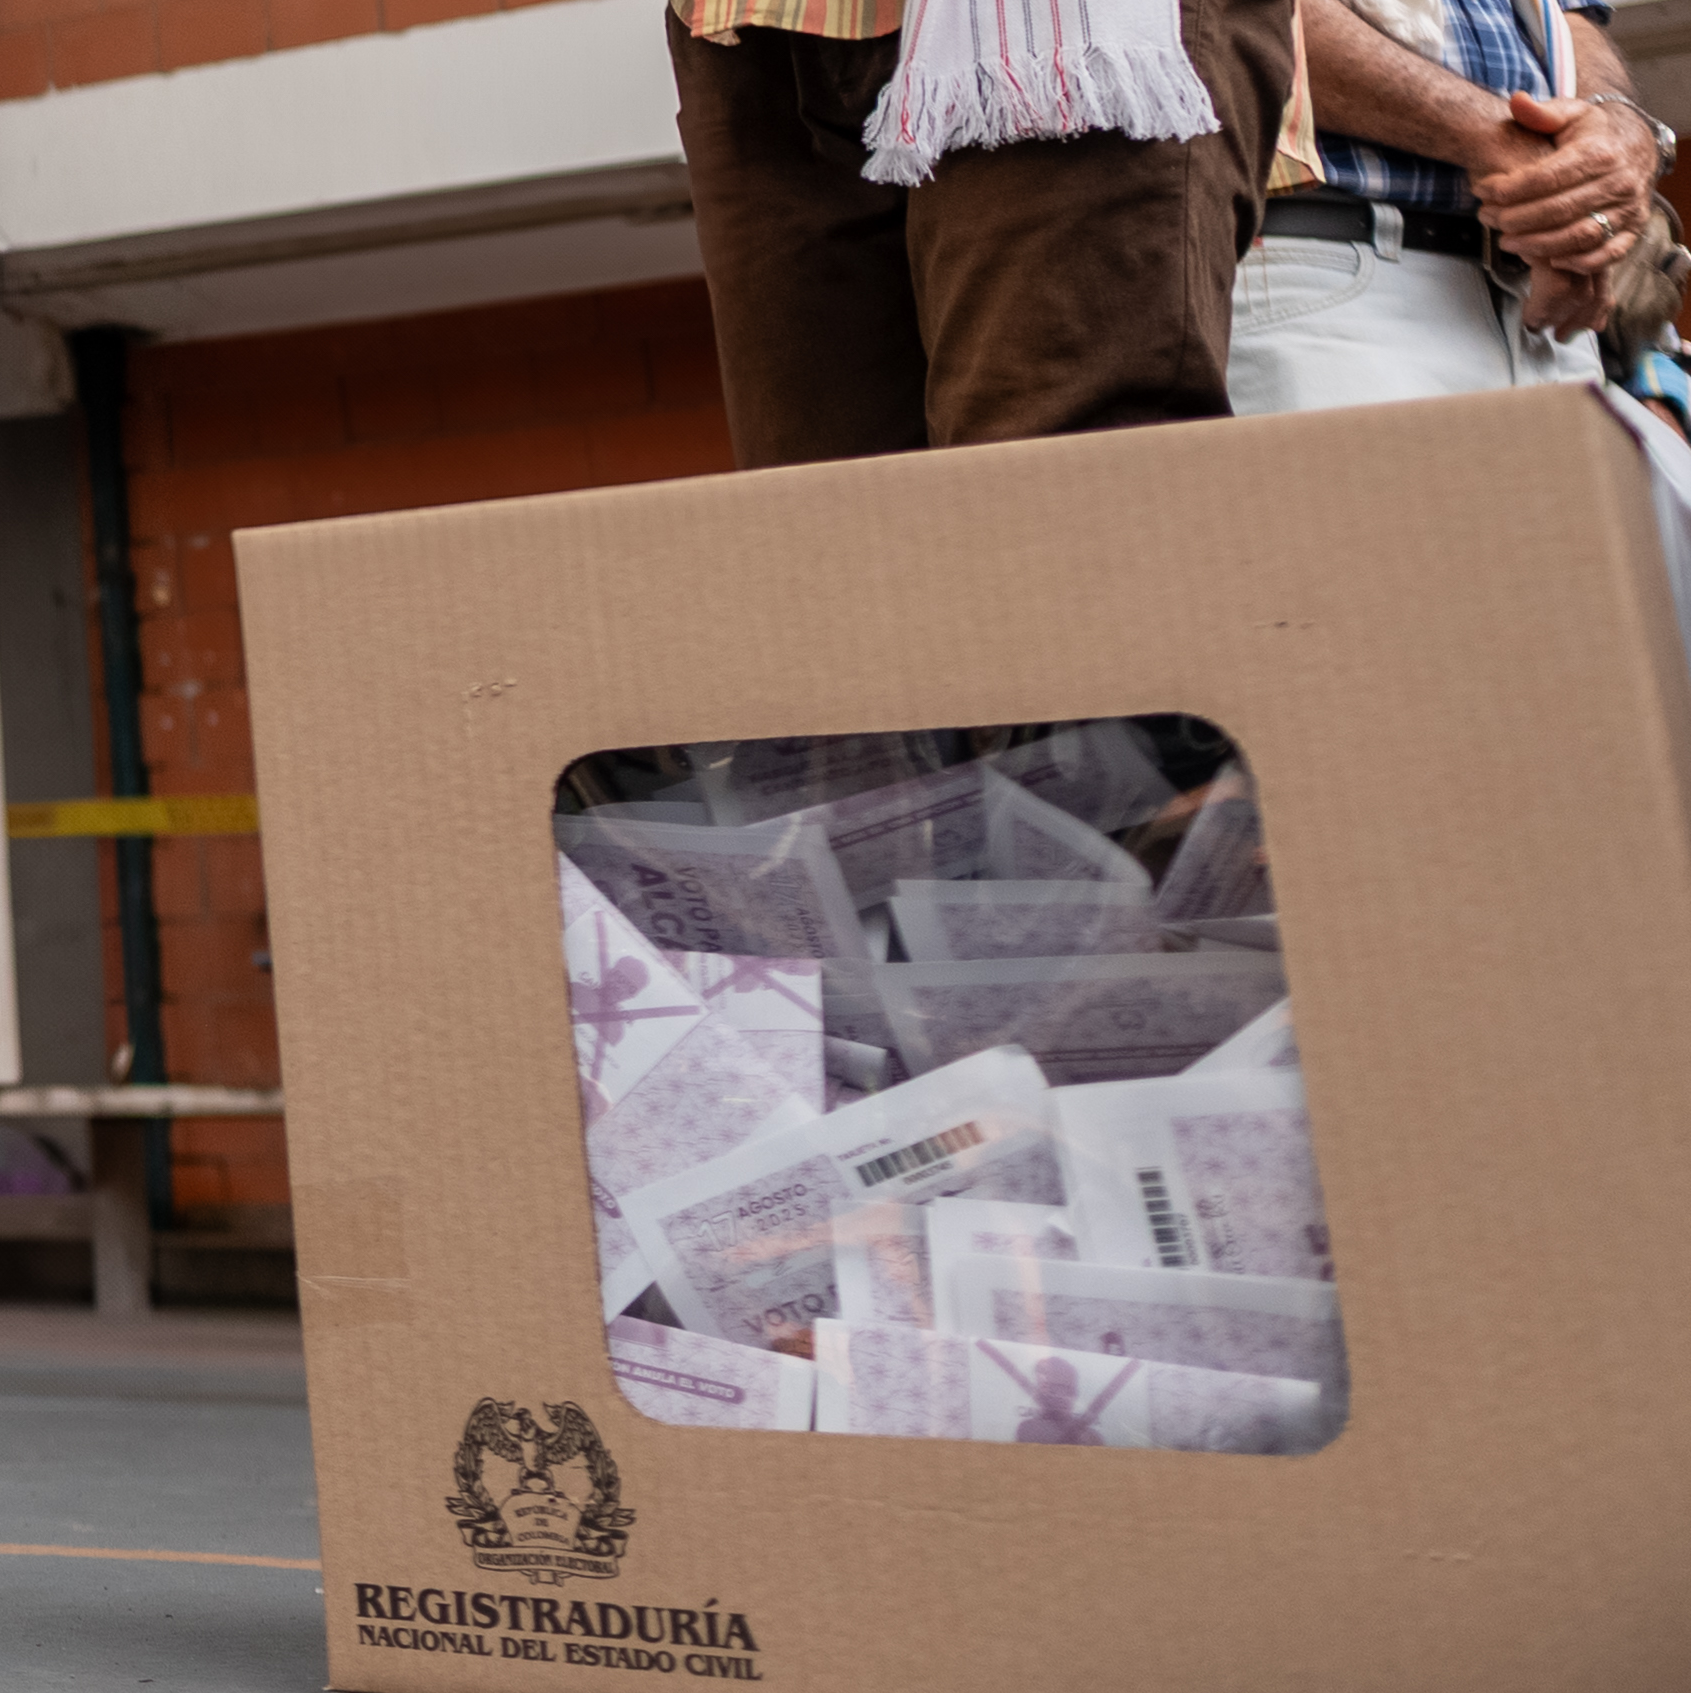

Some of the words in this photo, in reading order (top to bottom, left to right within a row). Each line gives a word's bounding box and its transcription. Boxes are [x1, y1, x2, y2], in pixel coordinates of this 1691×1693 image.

[675, 866, 713, 922] VOTO
[694, 927, 723, 953] PA
[738, 1183, 808, 1219] AGOSTO
[756, 1206, 808, 1233] 2025
[742, 1292, 825, 1335] VOTO
[354, 1582, 760, 1652] REGISTRADURÍA
[357, 1624, 492, 1657] NACIONAL
[501, 1636, 556, 1662] DEL
[565, 1643, 675, 1673] ESTADO
[685, 1653, 763, 1681] CIVIL
